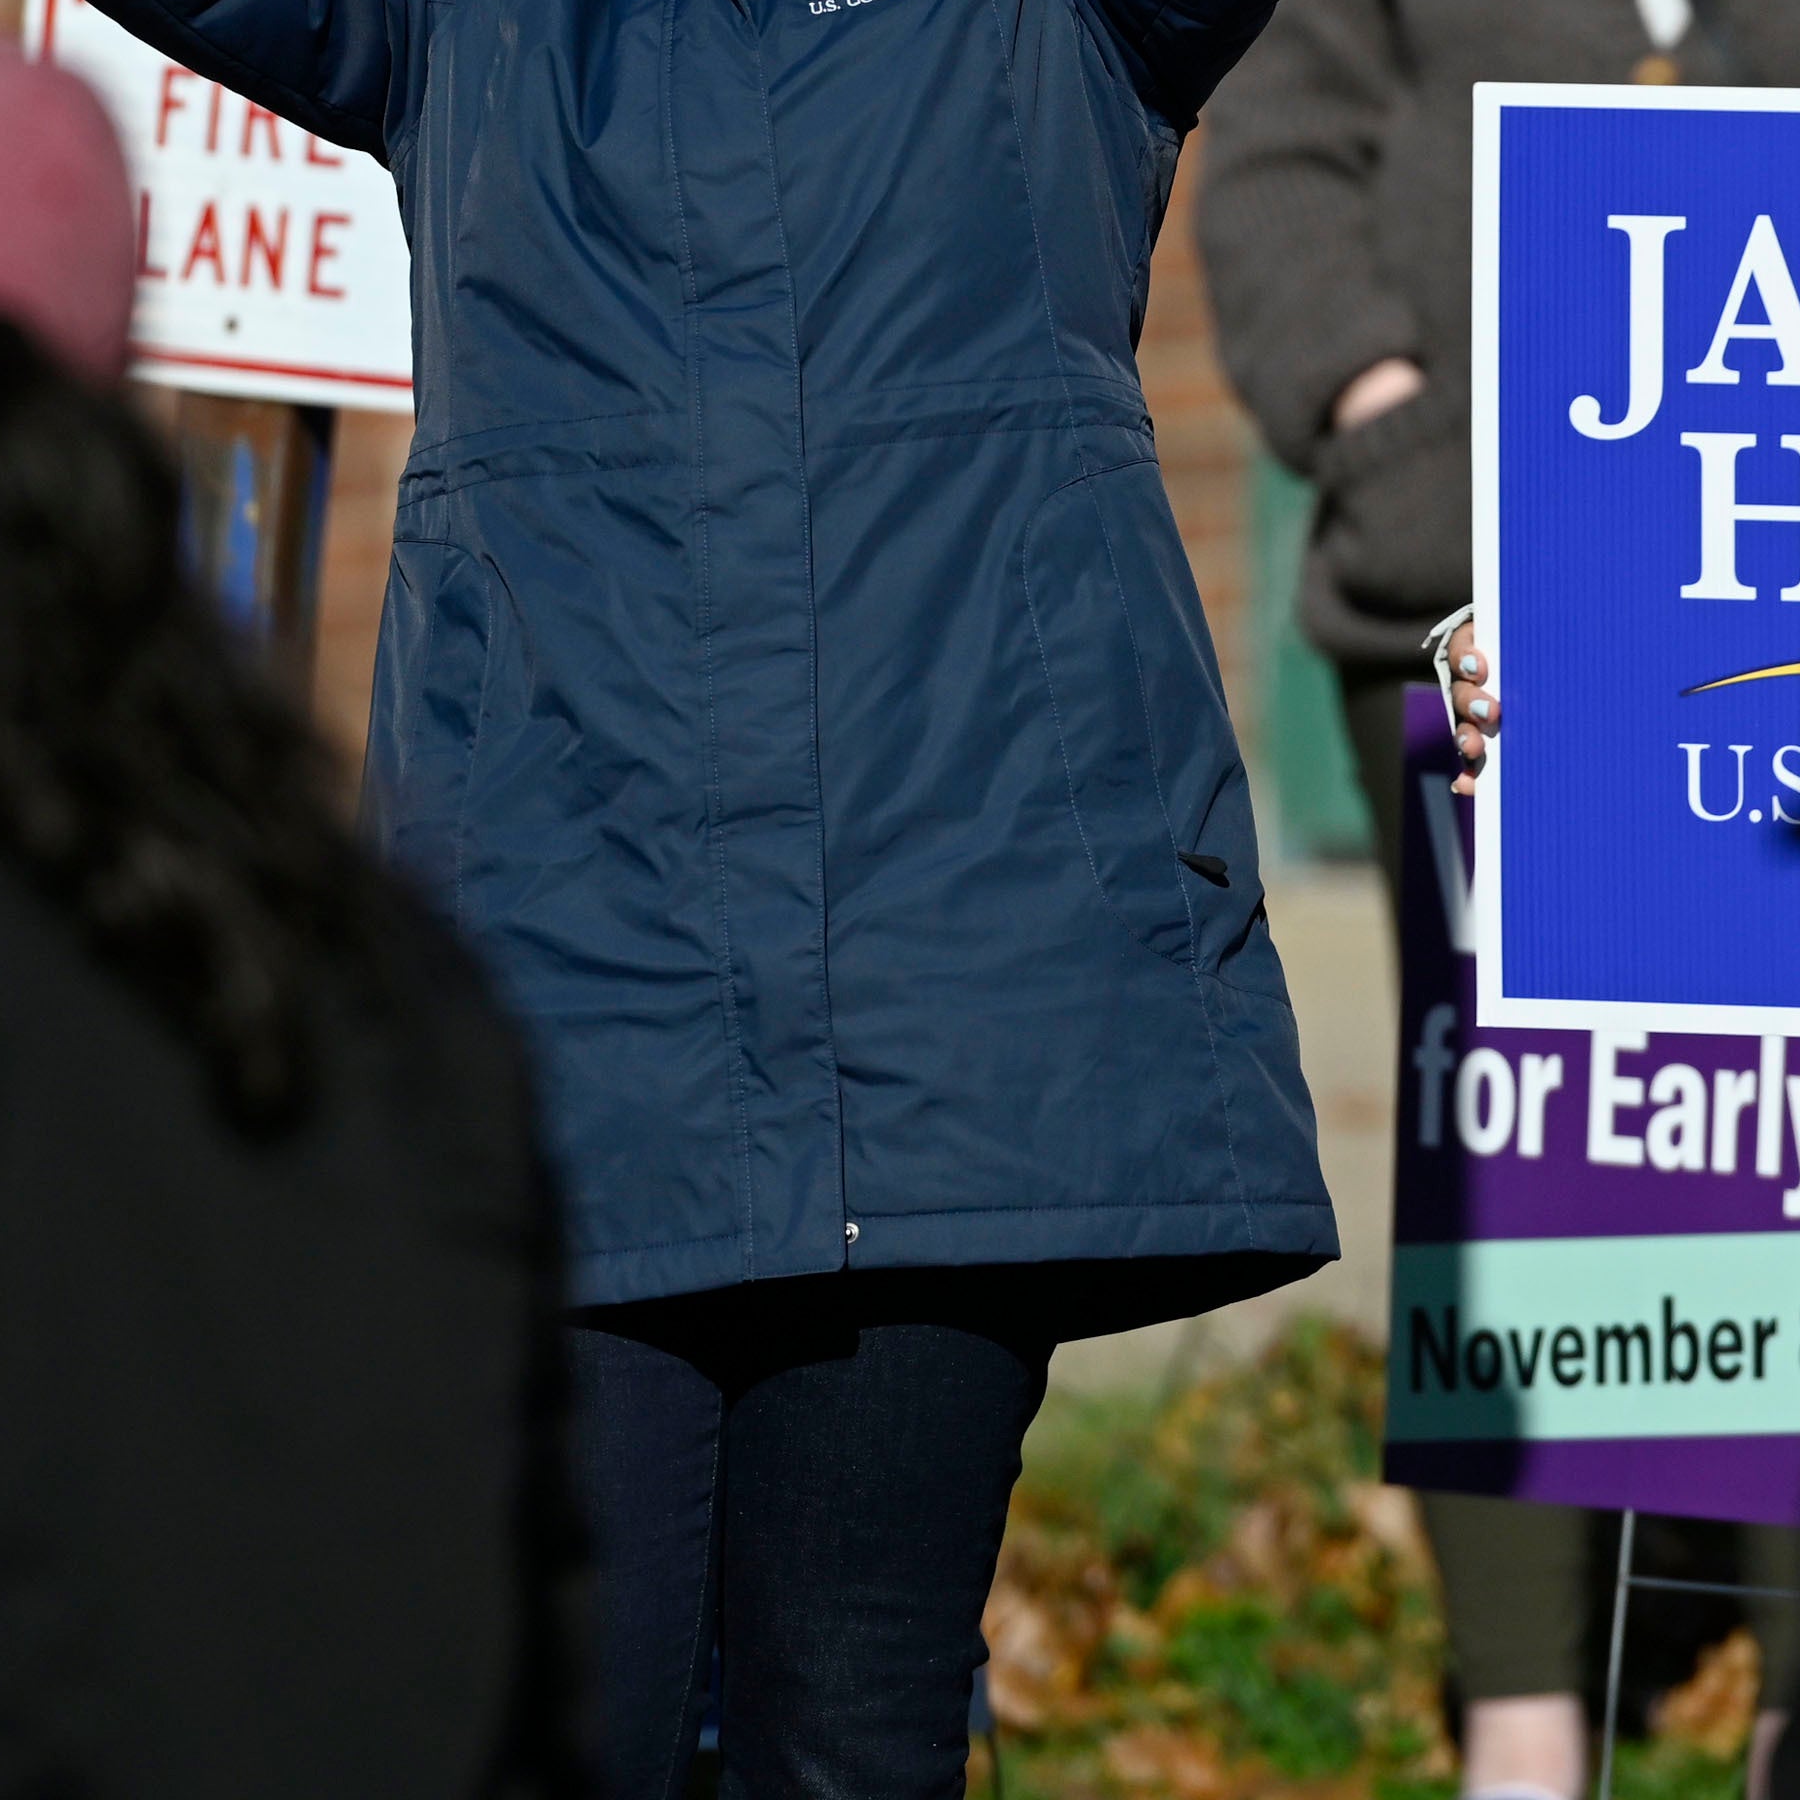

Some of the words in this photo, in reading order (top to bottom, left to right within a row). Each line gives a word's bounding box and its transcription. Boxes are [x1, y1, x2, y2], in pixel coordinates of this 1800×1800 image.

[809, 0, 841, 15] U.S.
[134, 192, 351, 300] LANE
[1413, 1003, 1563, 1159] for
[1410, 1296, 1777, 1394] November
